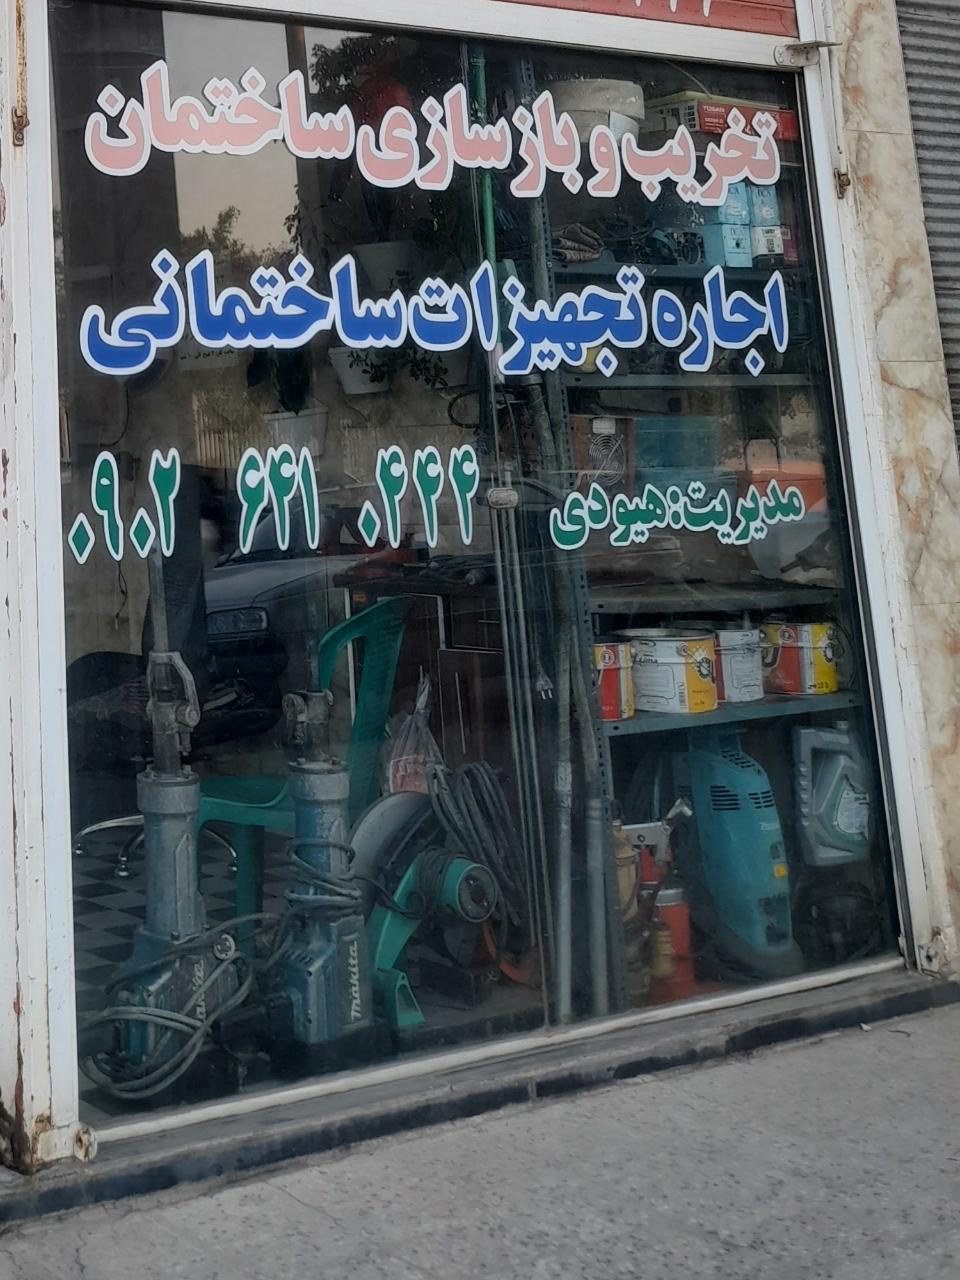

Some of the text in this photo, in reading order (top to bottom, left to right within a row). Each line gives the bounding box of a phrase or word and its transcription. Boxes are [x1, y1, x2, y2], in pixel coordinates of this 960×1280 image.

[85, 59, 354, 176] ساختمان
[622, 107, 780, 206] تخریب
[80, 247, 788, 377] اجاره تجهیزات ساختمانی
[67, 443, 479, 565] ۰۹۰۲ ۶۴۱ ۰۴۴۴
